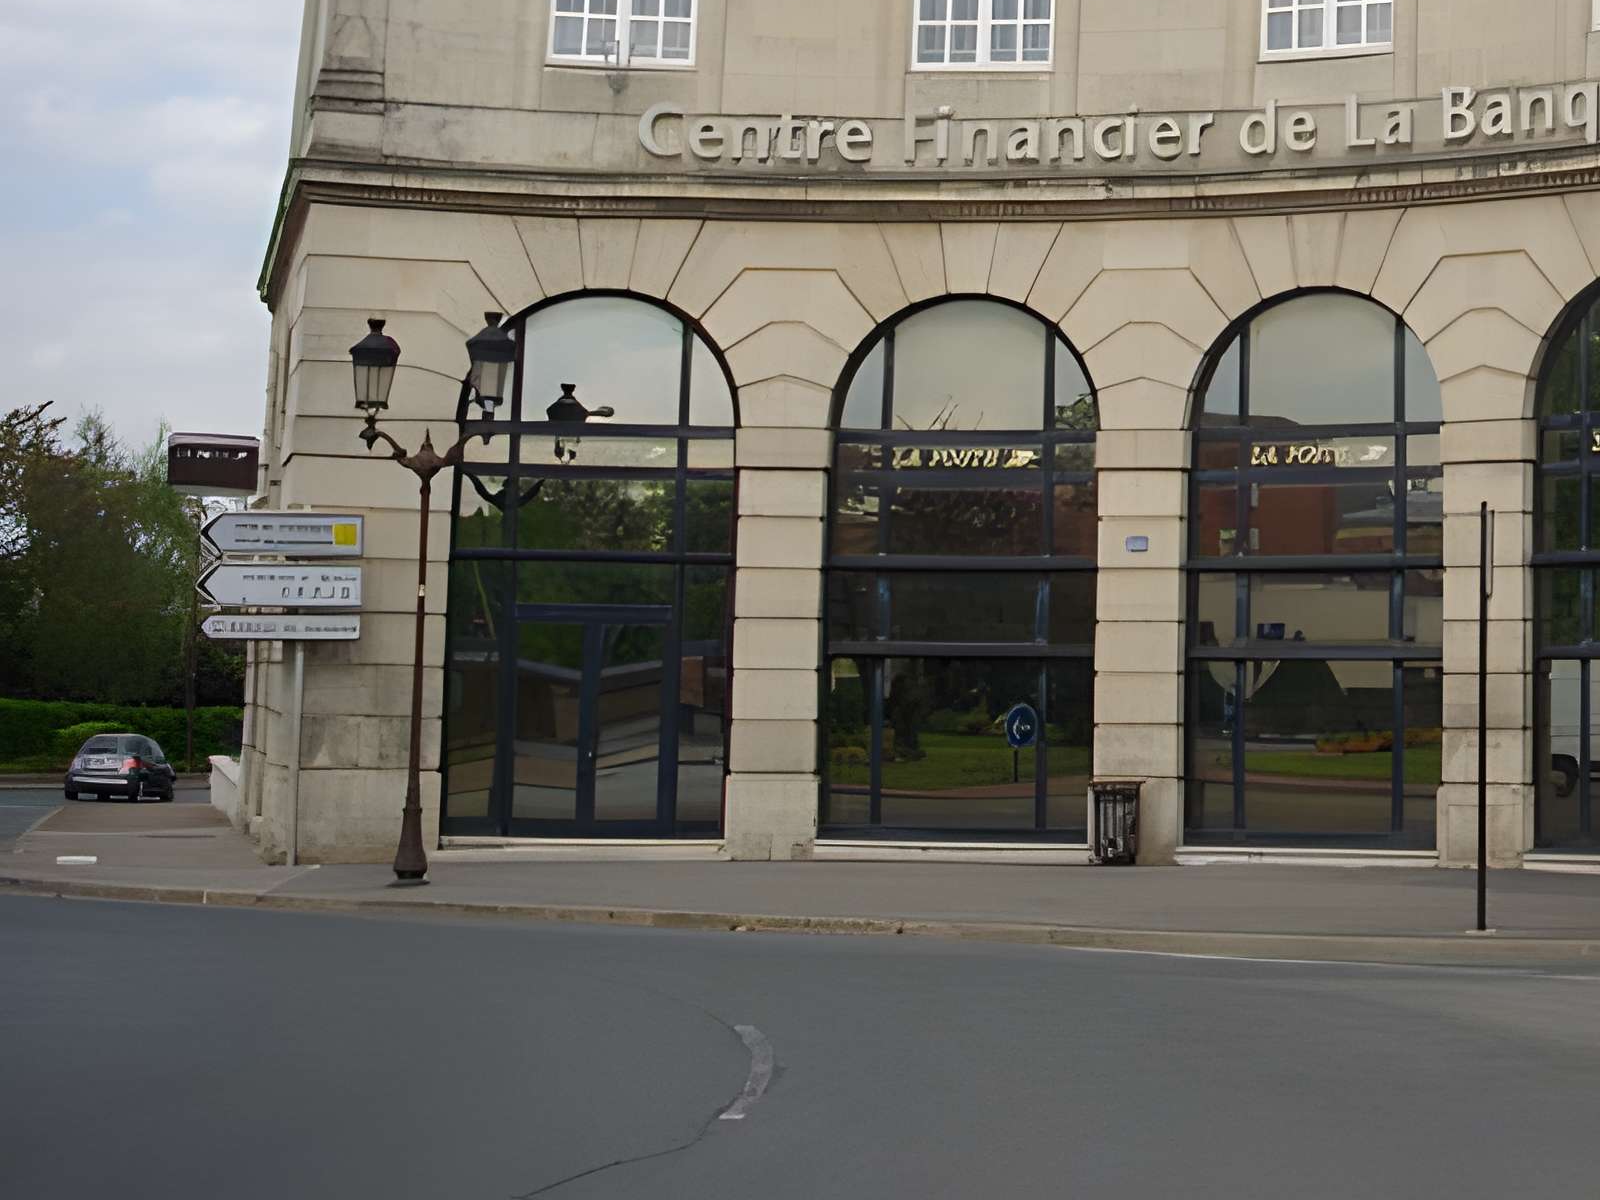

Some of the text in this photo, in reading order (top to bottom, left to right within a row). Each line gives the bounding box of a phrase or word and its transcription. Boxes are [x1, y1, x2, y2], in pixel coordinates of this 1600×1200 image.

[638, 102, 874, 163] Centre
[902, 103, 1215, 167] Financier
[1239, 99, 1319, 155] de
[1345, 93, 1414, 147] La
